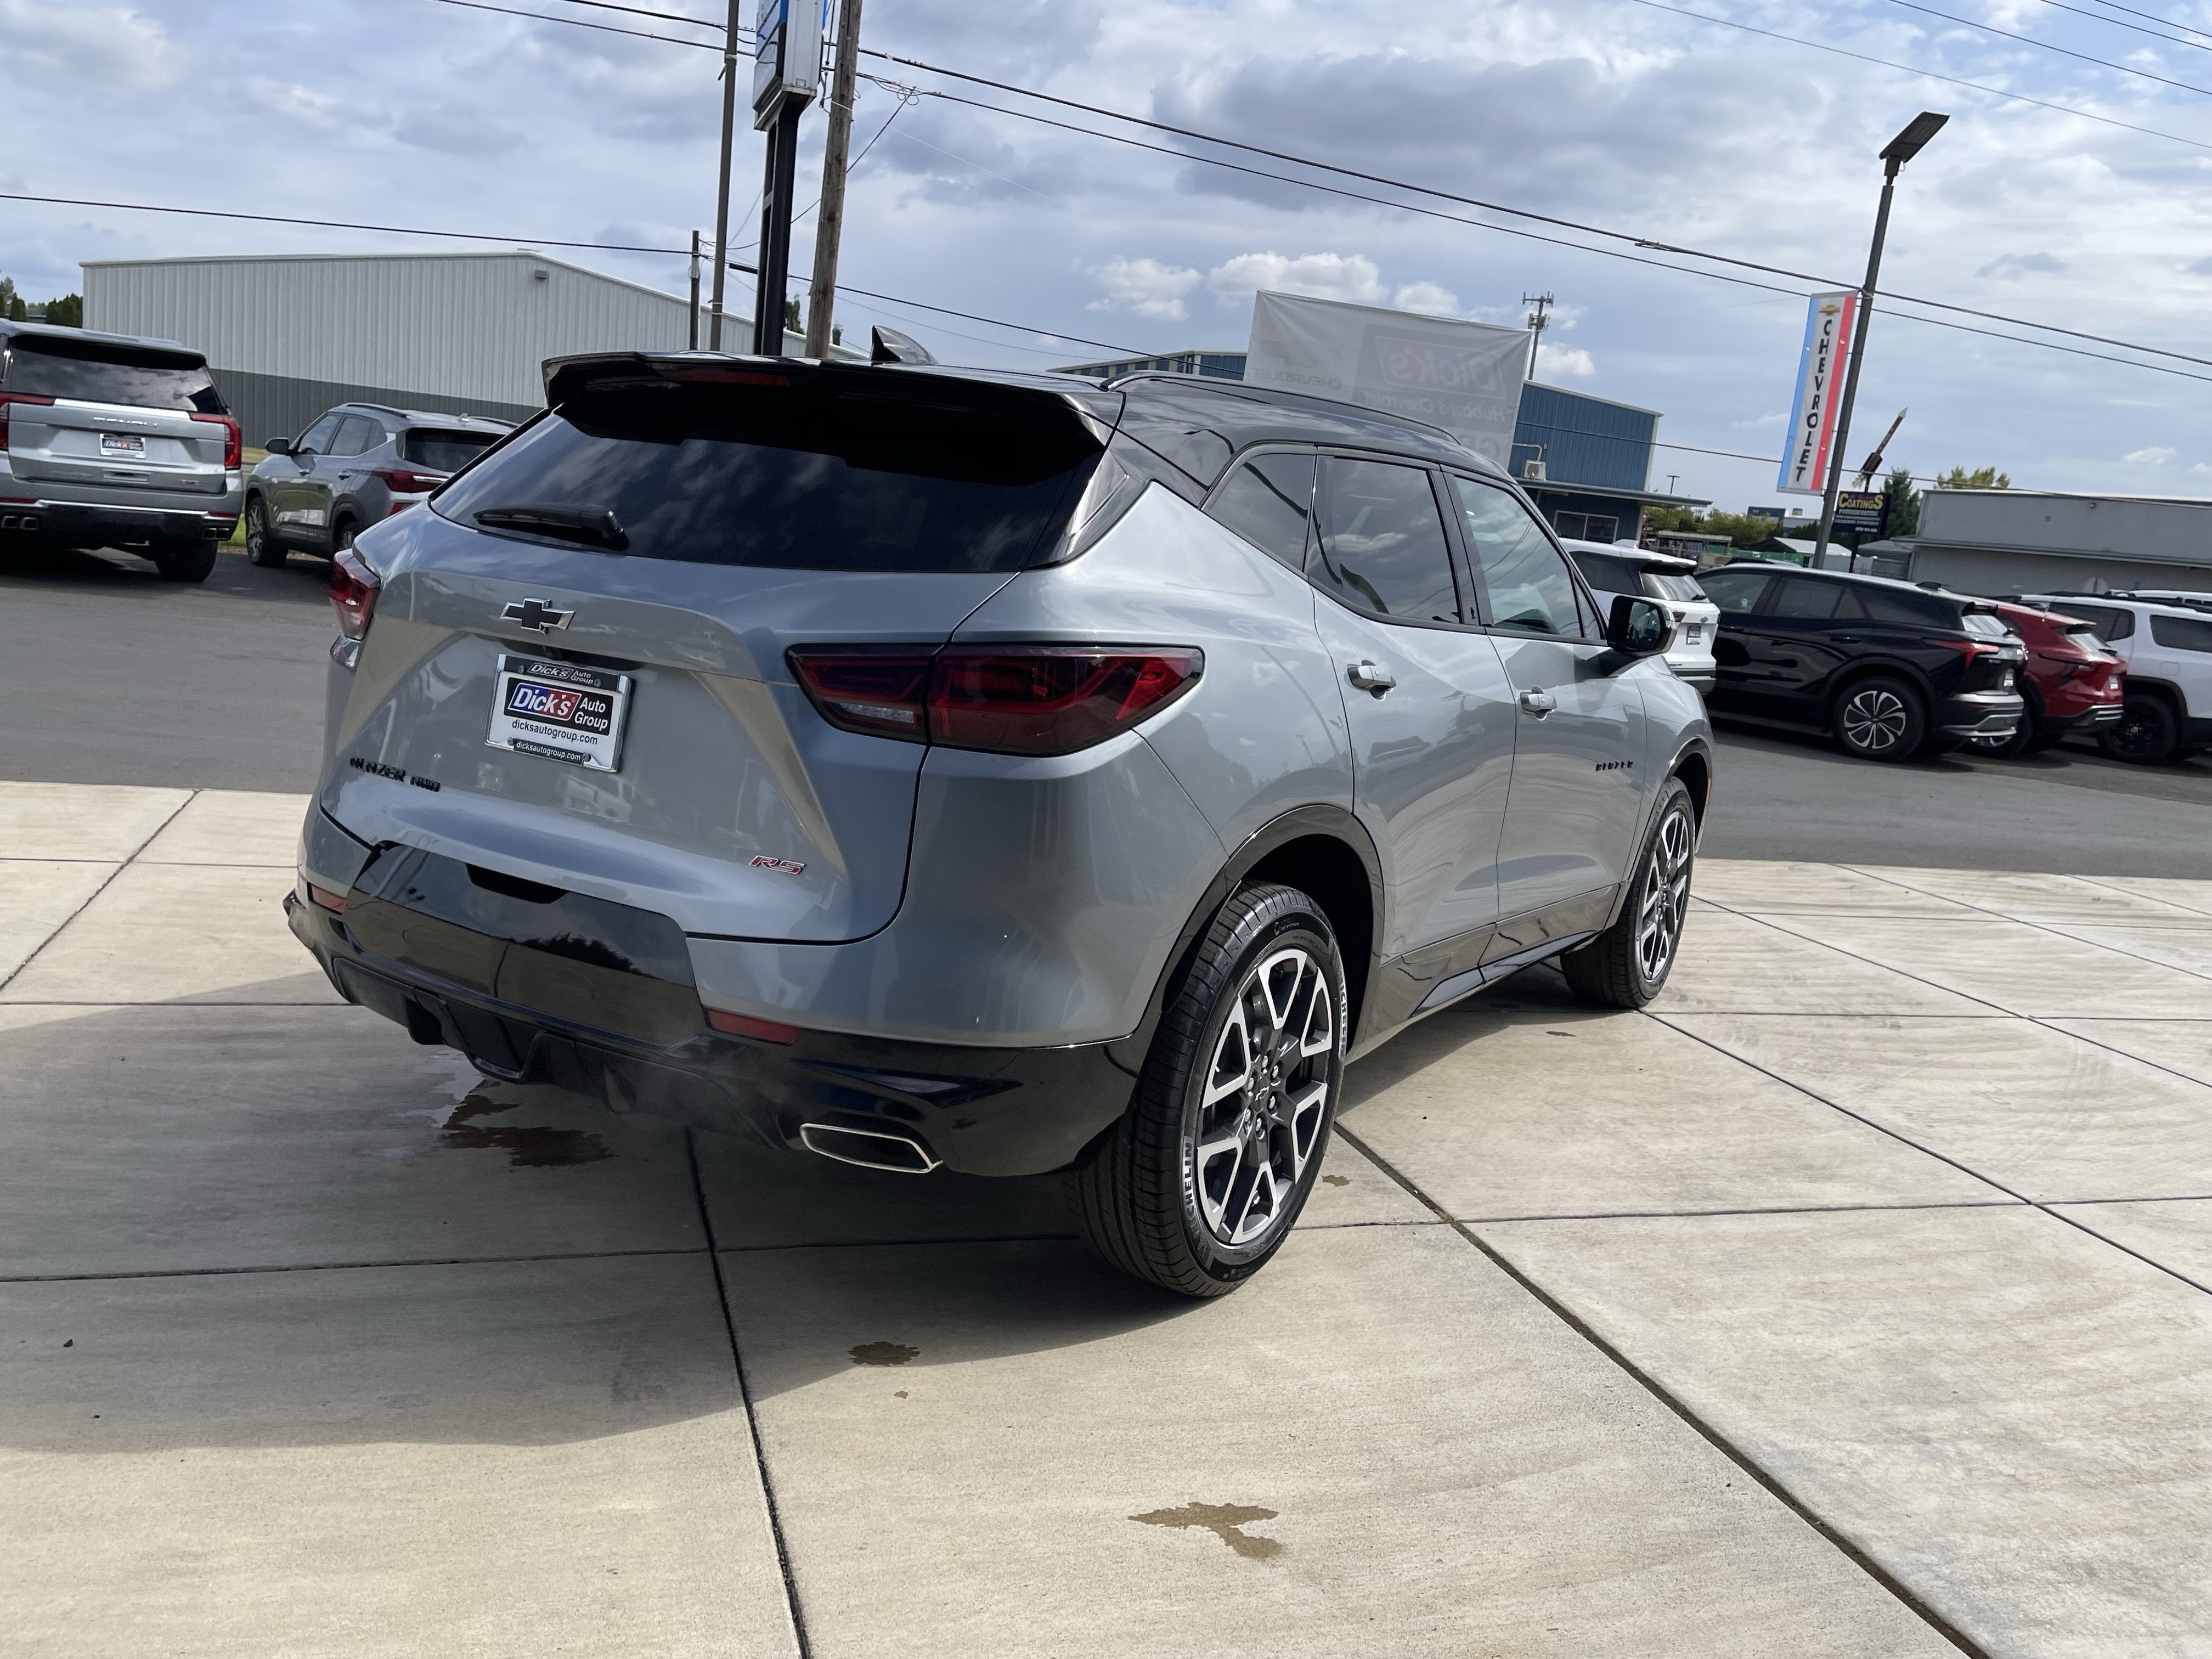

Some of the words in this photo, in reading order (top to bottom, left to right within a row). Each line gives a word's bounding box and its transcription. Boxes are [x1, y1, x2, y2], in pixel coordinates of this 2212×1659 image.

[1796, 320, 1832, 482] CHEVROLET
[531, 664, 569, 678] Dick's
[571, 675, 594, 685] Group
[573, 670, 591, 679] Auto
[514, 687, 571, 717] Dick's
[579, 697, 606, 713] Auto
[574, 712, 608, 731] Group
[512, 719, 598, 744] dicksautogroup.com
[516, 741, 582, 761] dicksautogroup.com
[748, 855, 805, 874] RS
